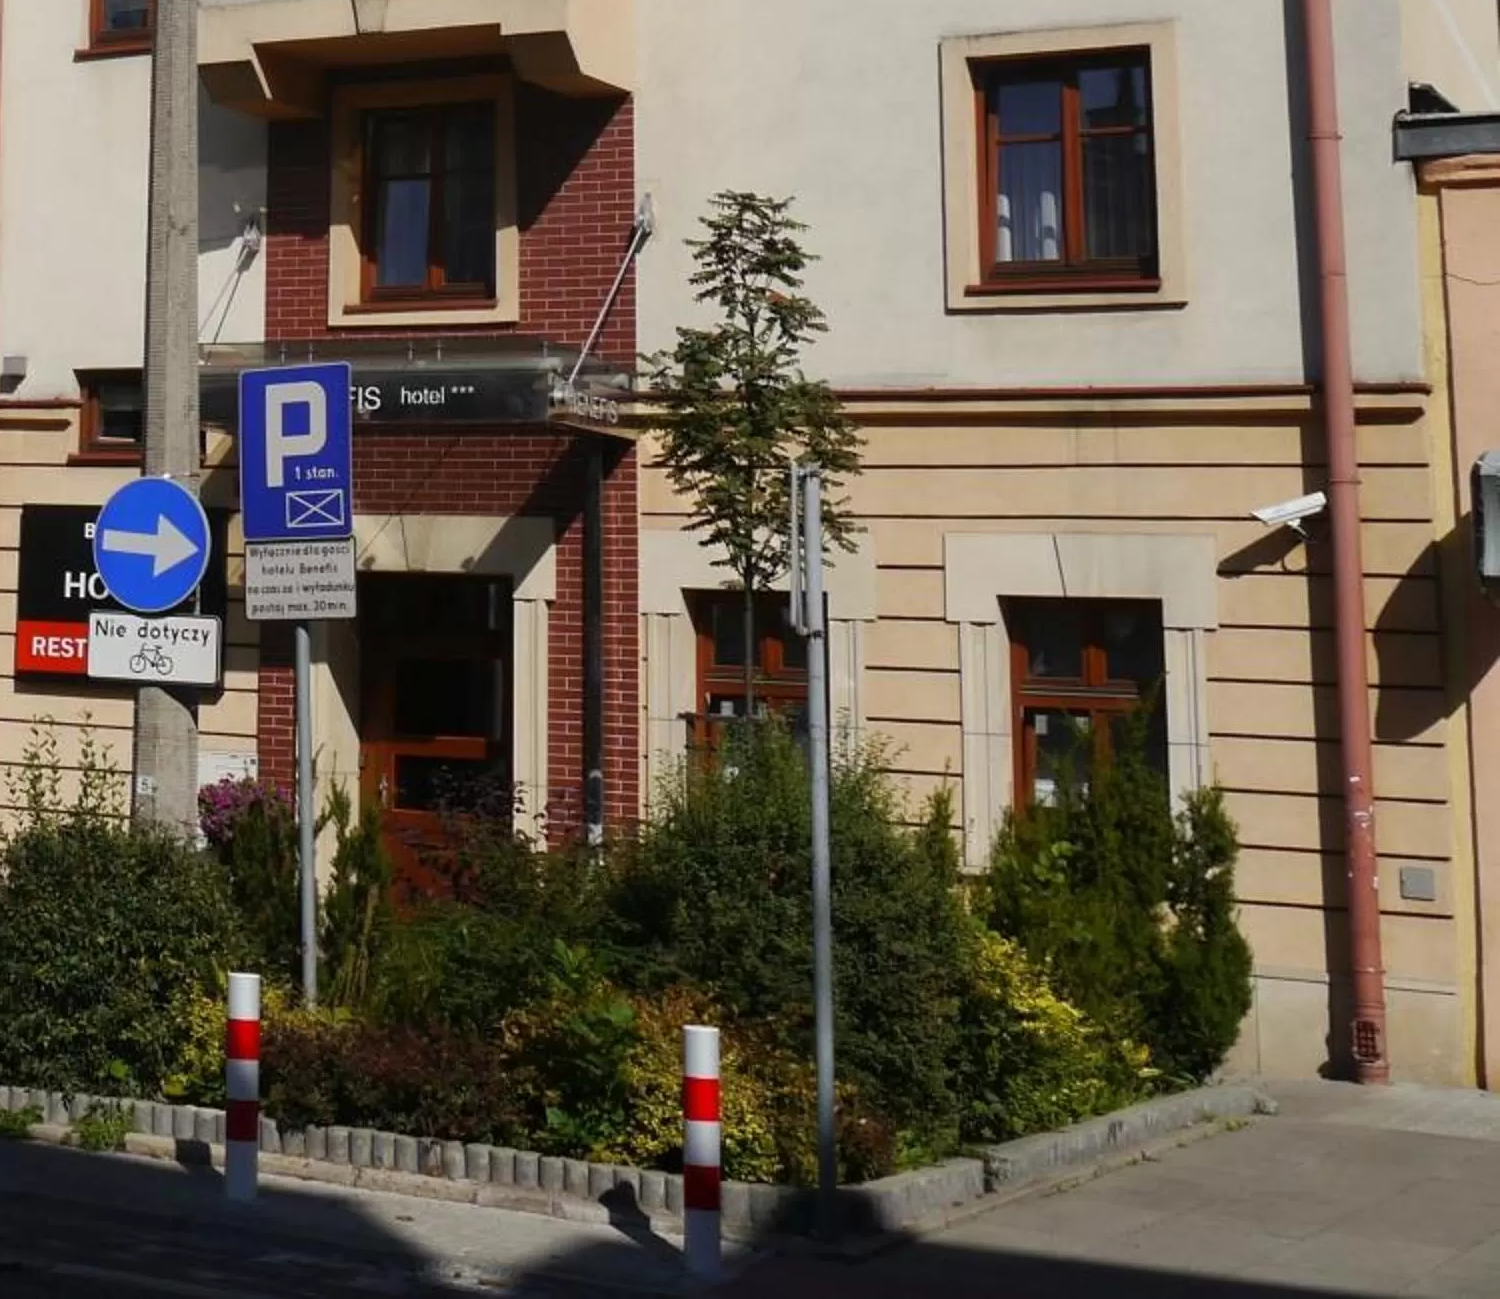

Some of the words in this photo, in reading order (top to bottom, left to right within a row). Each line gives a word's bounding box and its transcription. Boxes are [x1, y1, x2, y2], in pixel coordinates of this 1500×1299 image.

[401, 386, 445, 405] hotel
[265, 381, 327, 488] P
[95, 620, 127, 638] Nie
[137, 622, 212, 647] dotyczy
